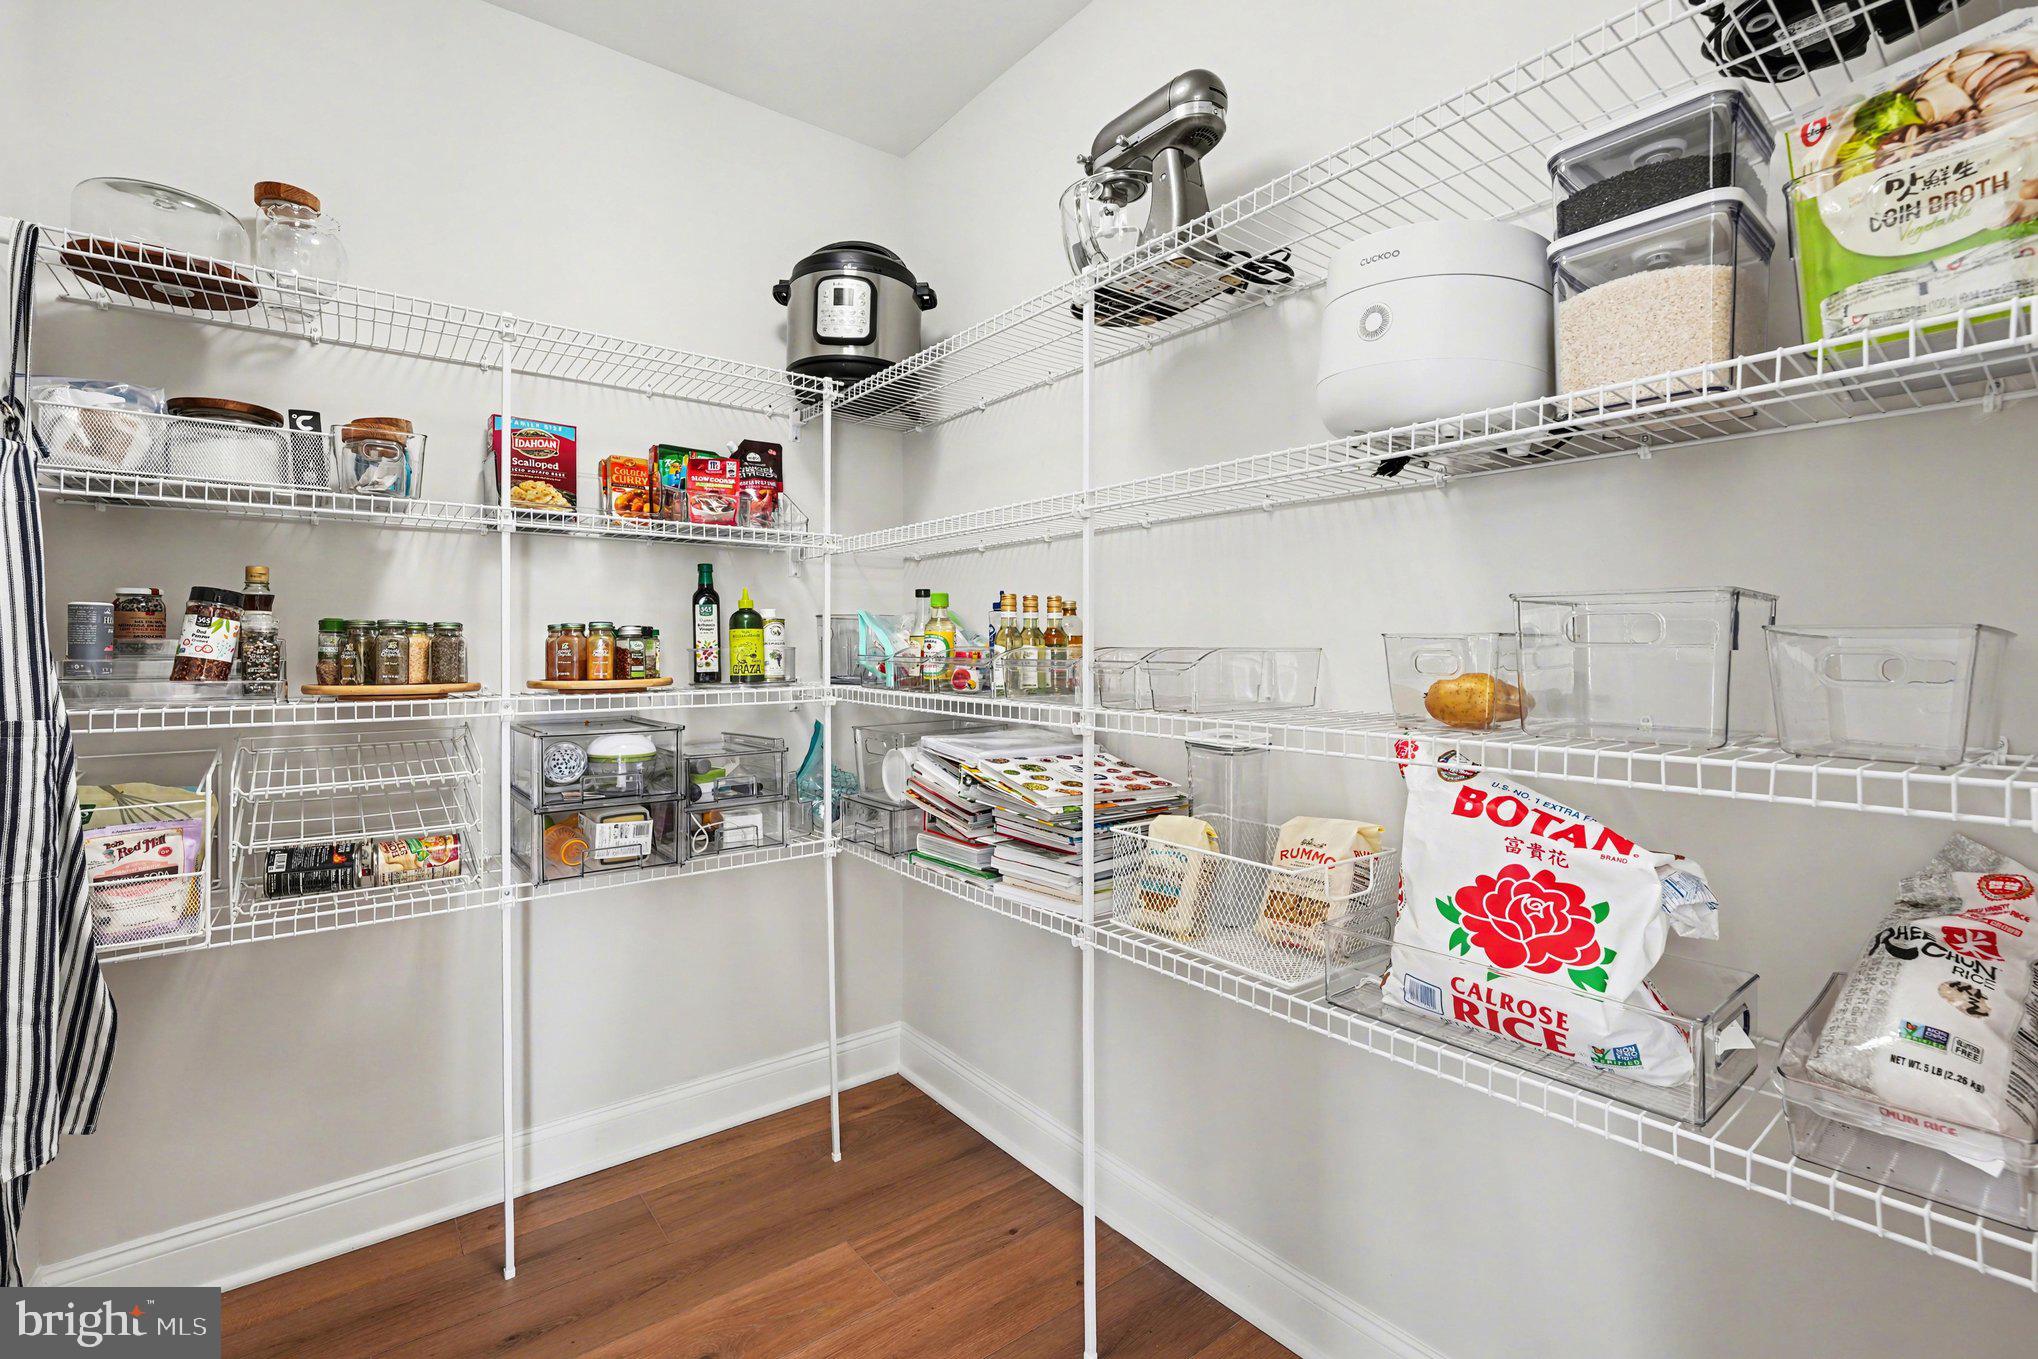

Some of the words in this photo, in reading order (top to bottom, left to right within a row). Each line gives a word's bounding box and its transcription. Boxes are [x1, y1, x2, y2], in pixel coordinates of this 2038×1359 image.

[1928, 170, 2010, 215] BROTH
[1359, 249, 1400, 267] CUCKOO
[515, 439, 557, 449] IDAHOAN
[511, 457, 559, 470] Scalloped
[614, 466, 648, 478] GOLDEN
[612, 474, 649, 486] CURRY
[732, 663, 762, 675] GRAZA
[1491, 781, 1510, 792] U.S.
[1513, 789, 1531, 801] NO.
[1543, 801, 1581, 820] EXTRA
[1451, 784, 1635, 856] BOTAN
[116, 841, 141, 861] Red
[142, 833, 167, 854] Mill
[1503, 835, 1570, 869] 富貴花
[1600, 853, 1628, 865] BRAND
[1868, 925, 1938, 961] RHEE
[1920, 941, 1998, 981] CHUN
[1951, 965, 1998, 991] RICE
[1450, 976, 1570, 1032] CALROSE
[1452, 993, 1576, 1058] RICE
[1955, 1046, 1980, 1062] FREE
[1890, 1053, 1906, 1066] NET
[1908, 1058, 1922, 1071] WT.
[1923, 1063, 1930, 1073] 5
[1931, 1065, 1943, 1077] LB
[1944, 1069, 1968, 1087] (2.26
[1970, 1079, 1985, 1094] kg)
